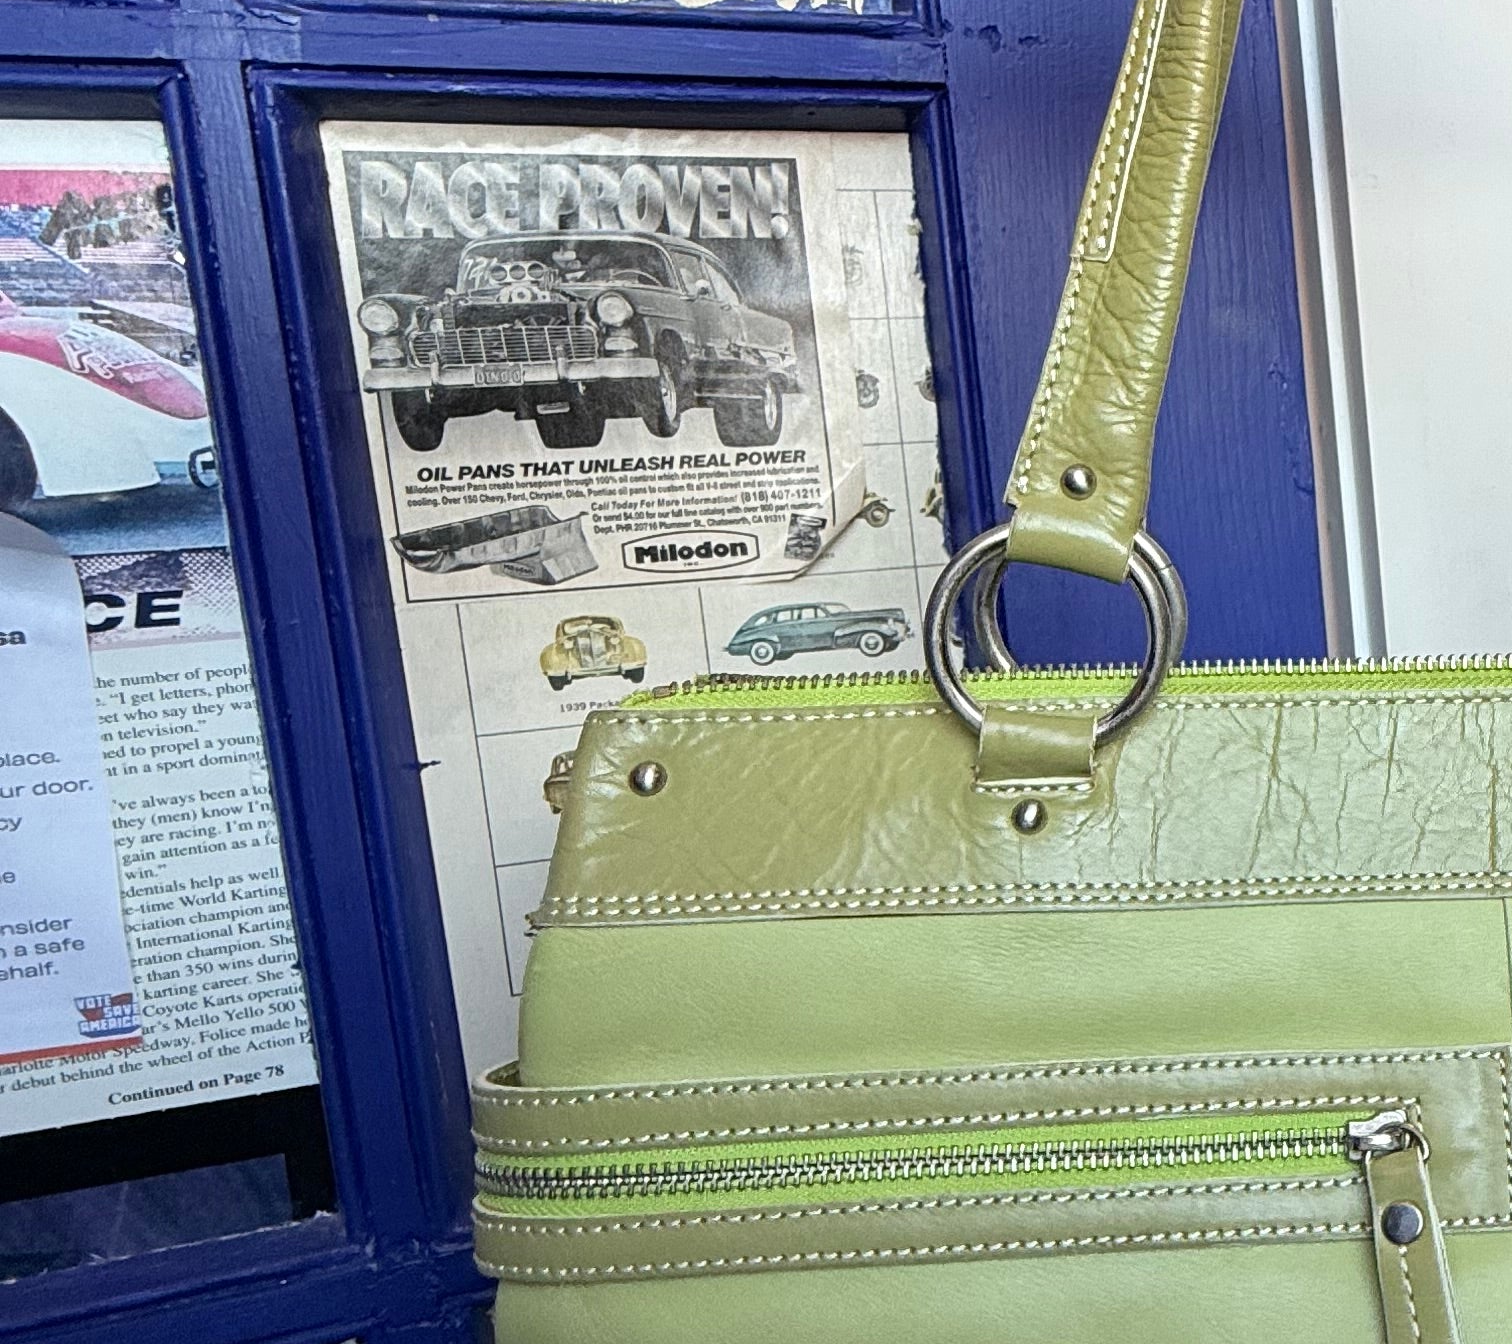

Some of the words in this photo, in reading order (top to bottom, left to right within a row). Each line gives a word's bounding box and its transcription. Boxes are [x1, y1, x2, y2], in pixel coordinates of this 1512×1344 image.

[359, 159, 522, 241] RACE
[538, 160, 792, 241] PROVEN!
[417, 466, 453, 482] OIL
[458, 463, 514, 480] PANS
[520, 461, 574, 477] THAT
[579, 455, 674, 474] UNLEASH
[679, 453, 731, 469] REAL
[735, 450, 806, 466] POWER
[591, 502, 610, 511] Call
[612, 500, 638, 510] Today
[640, 499, 655, 509] For
[658, 498, 680, 508] More
[741, 491, 769, 504] (818)
[771, 488, 821, 501] 407-1211
[634, 541, 748, 564] Milodon
[120, 671, 180, 687] number
[185, 668, 201, 681] of
[560, 702, 586, 712] 1939
[32, 778, 94, 796] door.
[112, 817, 146, 830] they
[151, 810, 197, 827] (men)
[201, 806, 243, 821] know
[14, 946, 27, 957] a
[34, 937, 86, 956] safe
[136, 928, 234, 950] International
[75, 994, 111, 1010] VOTE
[79, 1017, 140, 1034] AMERICA
[175, 1013, 220, 1030] Mello
[224, 1007, 264, 1022] Yello
[268, 1000, 296, 1014] 500
[108, 1082, 194, 1106] Continued
[199, 1078, 219, 1090] on
[223, 1070, 262, 1088] Page
[265, 1064, 285, 1078] 78
